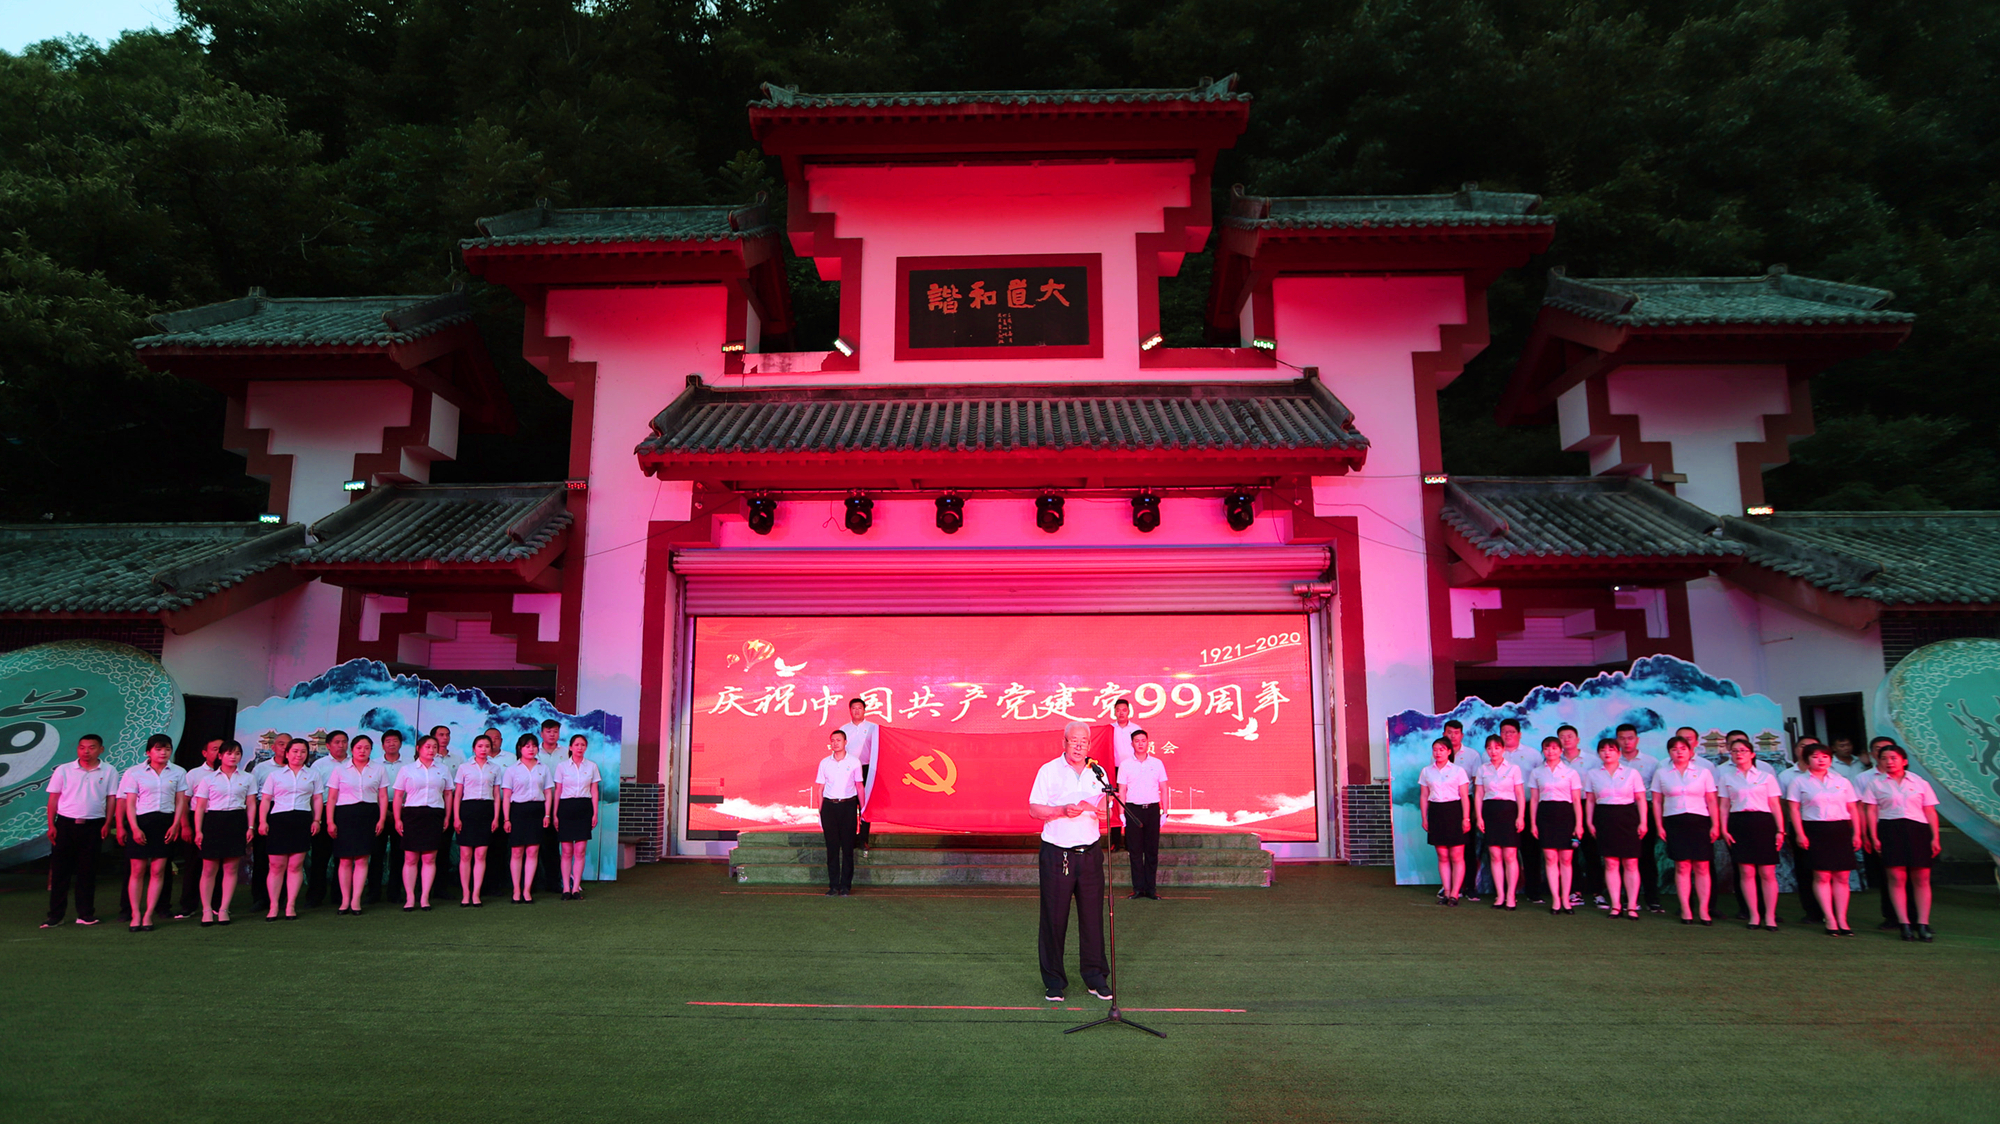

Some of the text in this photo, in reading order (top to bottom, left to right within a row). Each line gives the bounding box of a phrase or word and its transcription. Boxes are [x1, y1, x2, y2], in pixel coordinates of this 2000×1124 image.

[708, 680, 1290, 726] 庆祝中国共产党建党99周年
